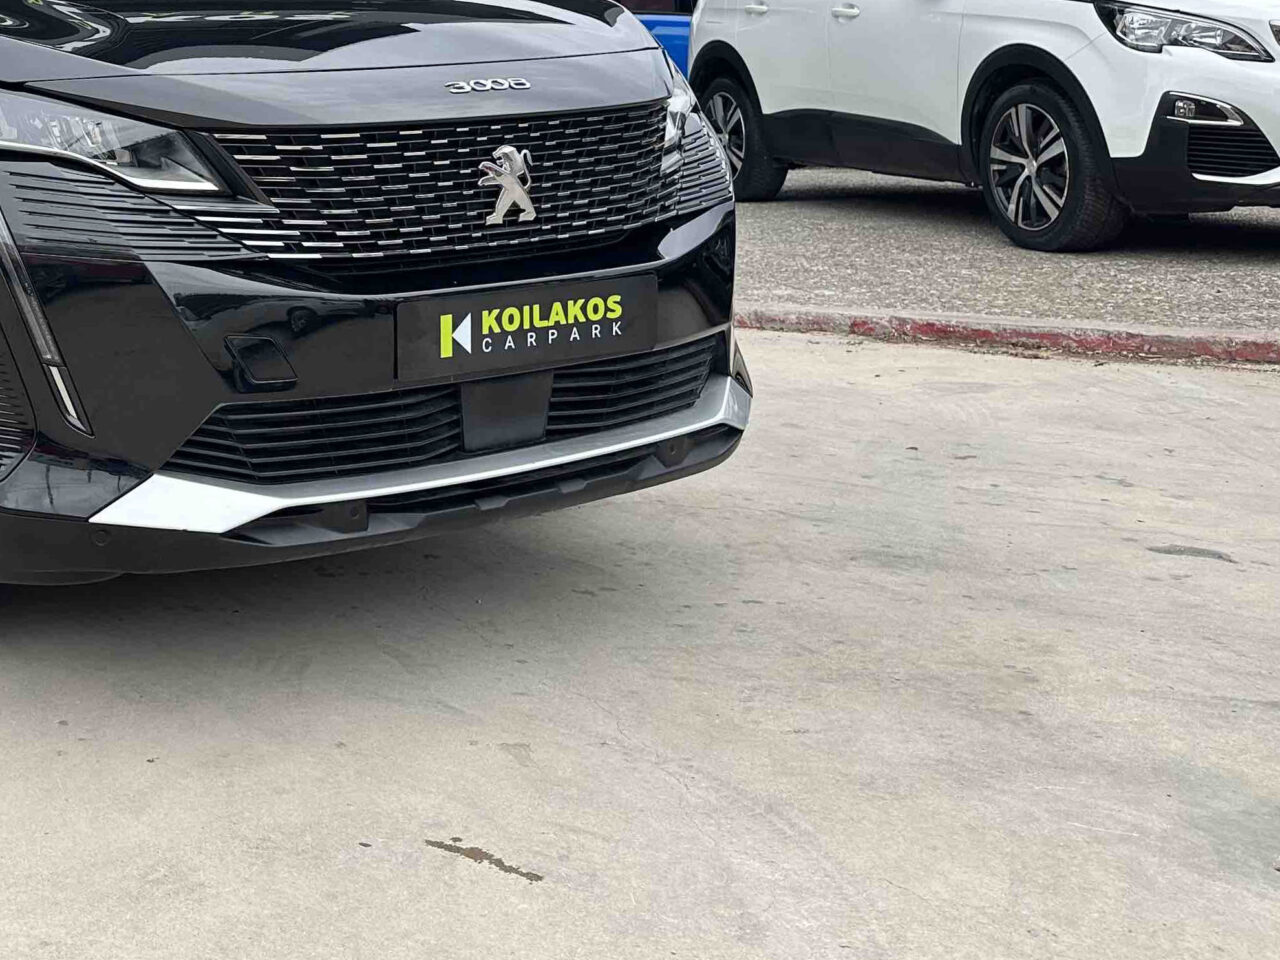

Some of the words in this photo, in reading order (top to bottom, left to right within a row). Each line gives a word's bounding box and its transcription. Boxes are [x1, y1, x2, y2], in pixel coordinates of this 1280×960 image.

[444, 76, 531, 95] 3008
[481, 294, 623, 335] KOILAKOS
[481, 321, 623, 353] CARPARK
